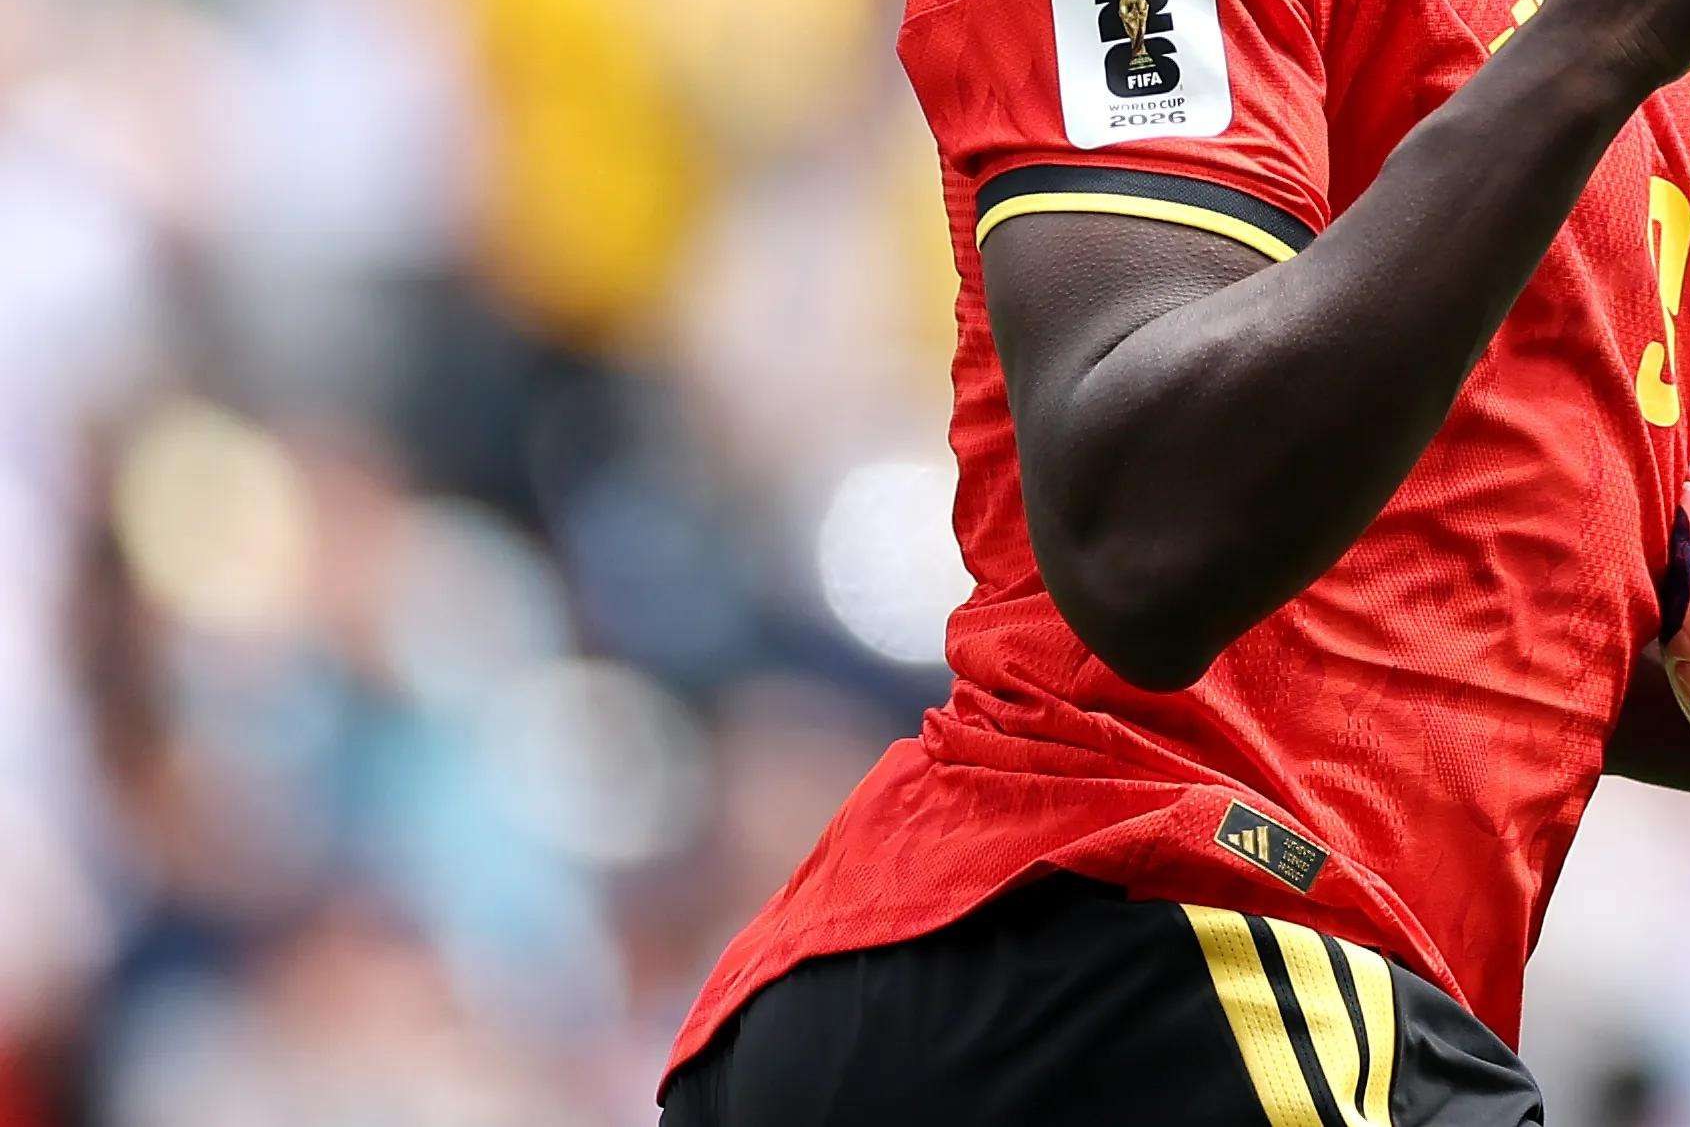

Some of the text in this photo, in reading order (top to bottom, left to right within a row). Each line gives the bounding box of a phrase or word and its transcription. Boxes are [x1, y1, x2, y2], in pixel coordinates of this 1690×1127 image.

[1127, 72, 1163, 90] FIFA
[1109, 97, 1186, 112] WORLD CUP
[1109, 110, 1187, 128] 2026
